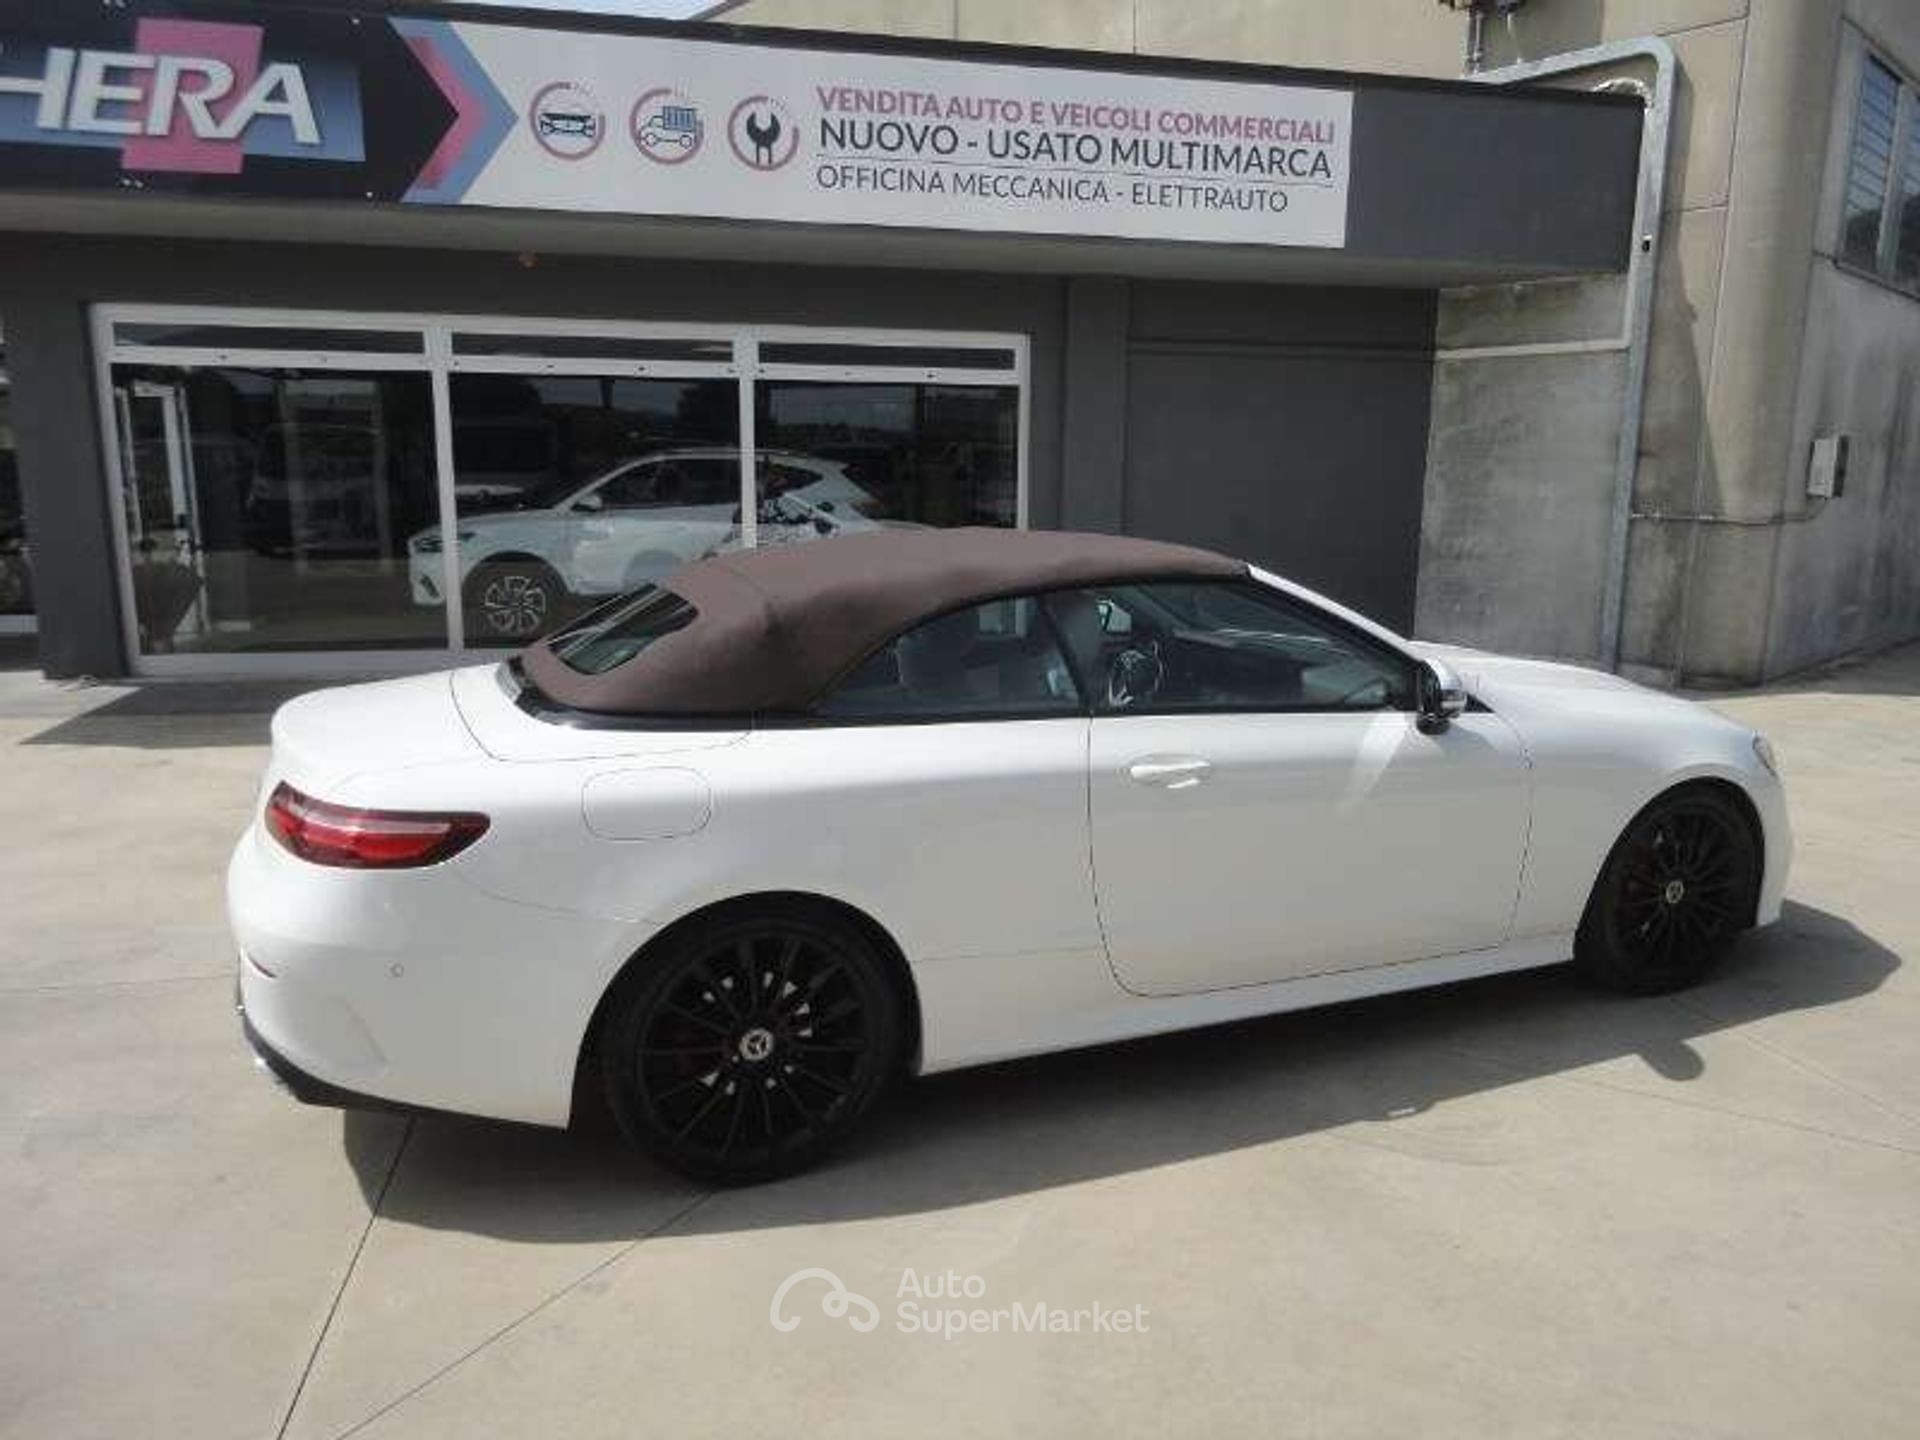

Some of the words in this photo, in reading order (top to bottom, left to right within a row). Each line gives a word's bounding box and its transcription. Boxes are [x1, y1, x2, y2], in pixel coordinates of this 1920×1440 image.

[817, 87, 939, 116] VENDITA
[945, 98, 1023, 122] AUTO
[1030, 102, 1045, 124] E
[1053, 102, 1151, 131] VEICOLI
[1157, 112, 1335, 143] COMMERCIALI
[819, 118, 959, 154] NUOVO
[987, 130, 1104, 164] USATO
[1111, 138, 1332, 179] MULTIMARCA
[817, 165, 945, 192] OFFICINA
[953, 174, 1109, 201] MECCANICA
[1131, 183, 1288, 212] ELETTRAUTO
